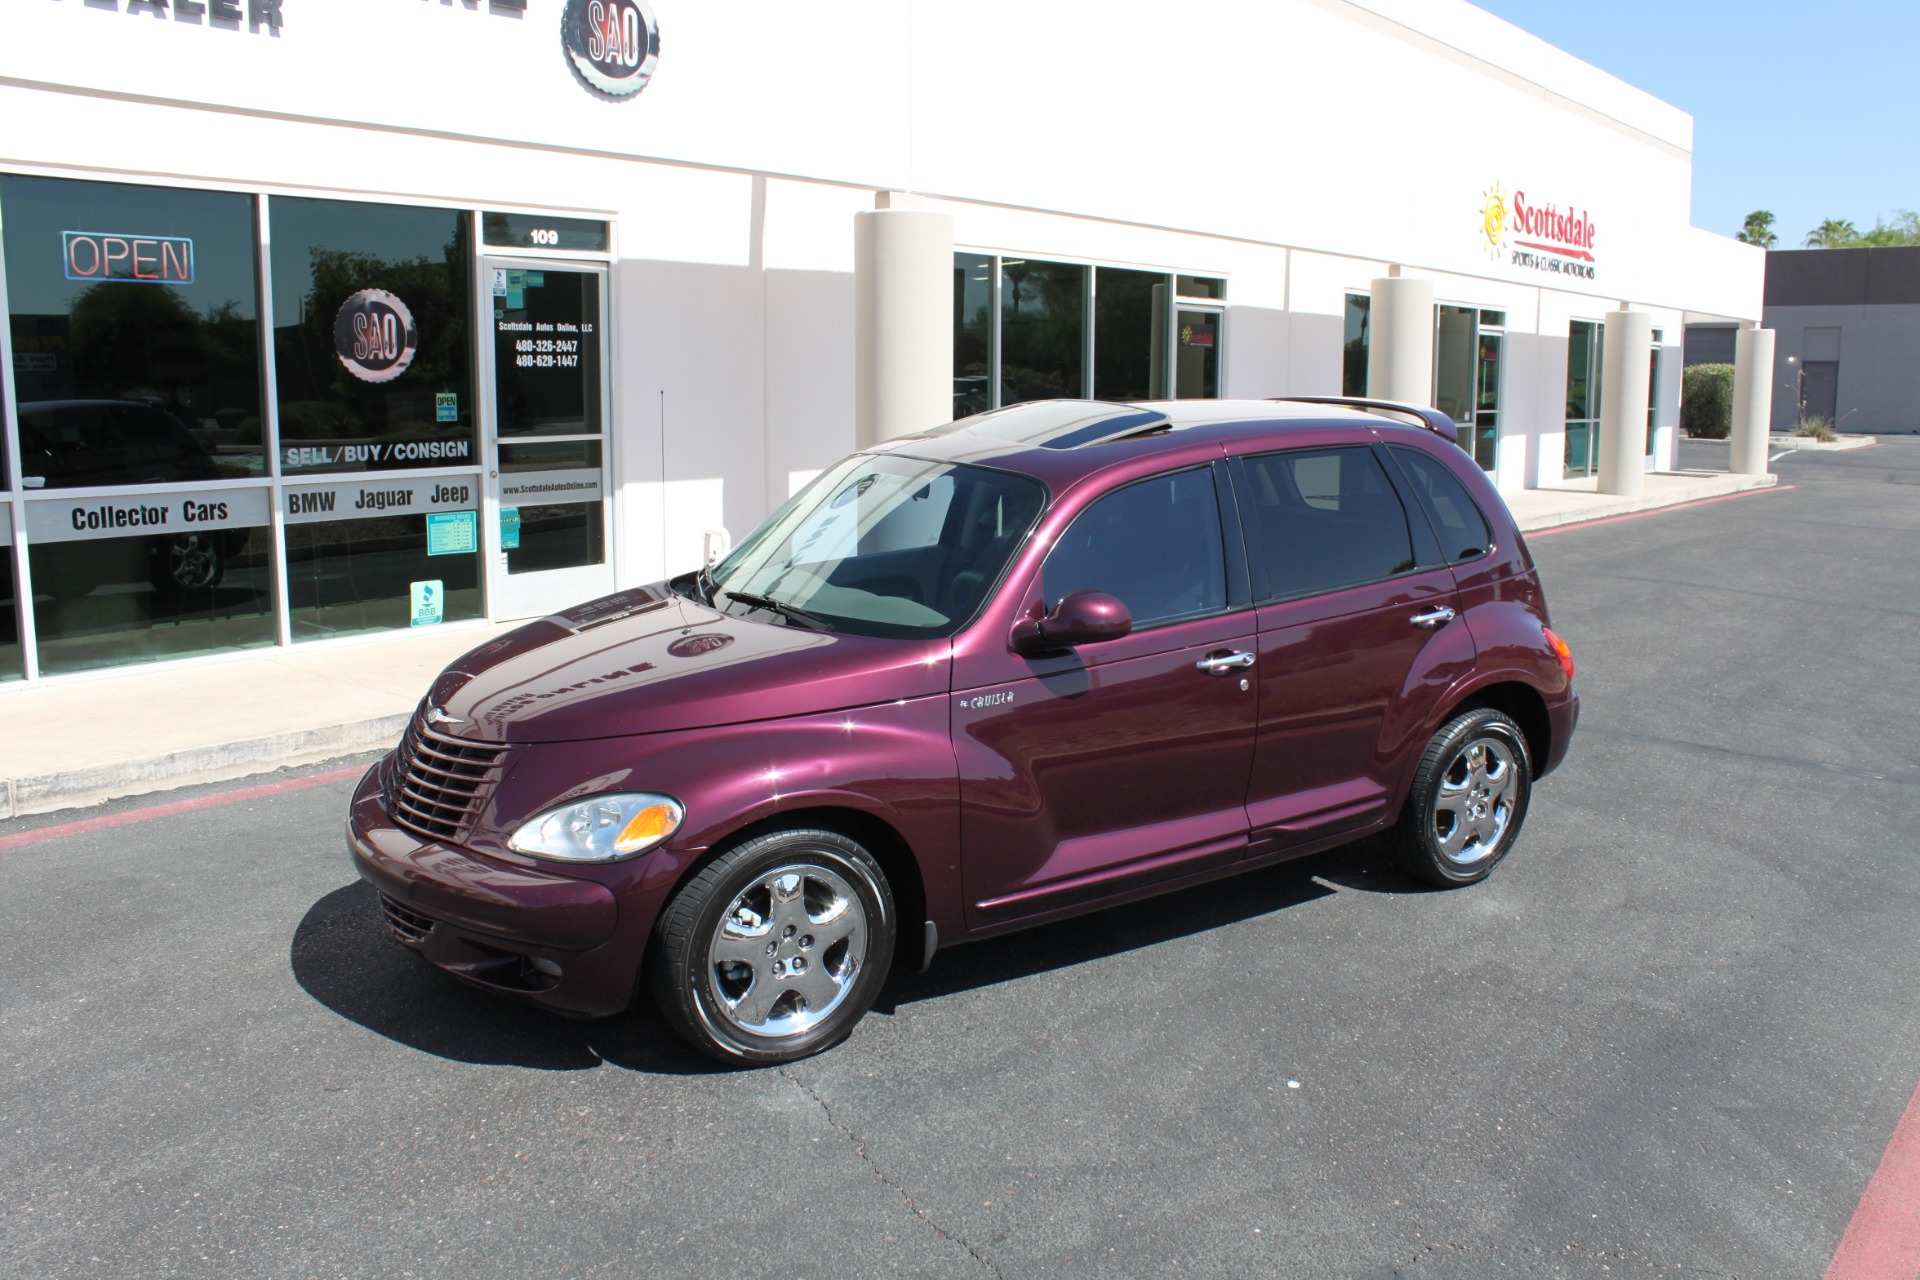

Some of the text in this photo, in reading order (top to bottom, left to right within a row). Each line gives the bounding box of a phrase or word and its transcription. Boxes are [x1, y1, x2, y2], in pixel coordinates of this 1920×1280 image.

[588, 0, 640, 67] SAO
[1513, 190, 1595, 249] Scottsdale
[530, 229, 559, 245] 109
[69, 236, 188, 280] OPEN
[1511, 250, 1534, 269] SPORTS
[1540, 256, 1563, 274] CLASSIC
[1562, 260, 1595, 280] MOTORCARS
[353, 312, 398, 360] SAO
[498, 321, 593, 333] Scottsdale Autos Online, LLC
[515, 340, 578, 352] 480-326-2447
[516, 355, 578, 367] 480-628-1447
[437, 396, 456, 406] OPEN
[288, 484, 469, 514] BMW Jaguar Jeep
[502, 481, 598, 495] www.ScottsdaleAutosOnline.com
[71, 500, 228, 530] Collector Cars
[418, 607, 437, 617] BBB
